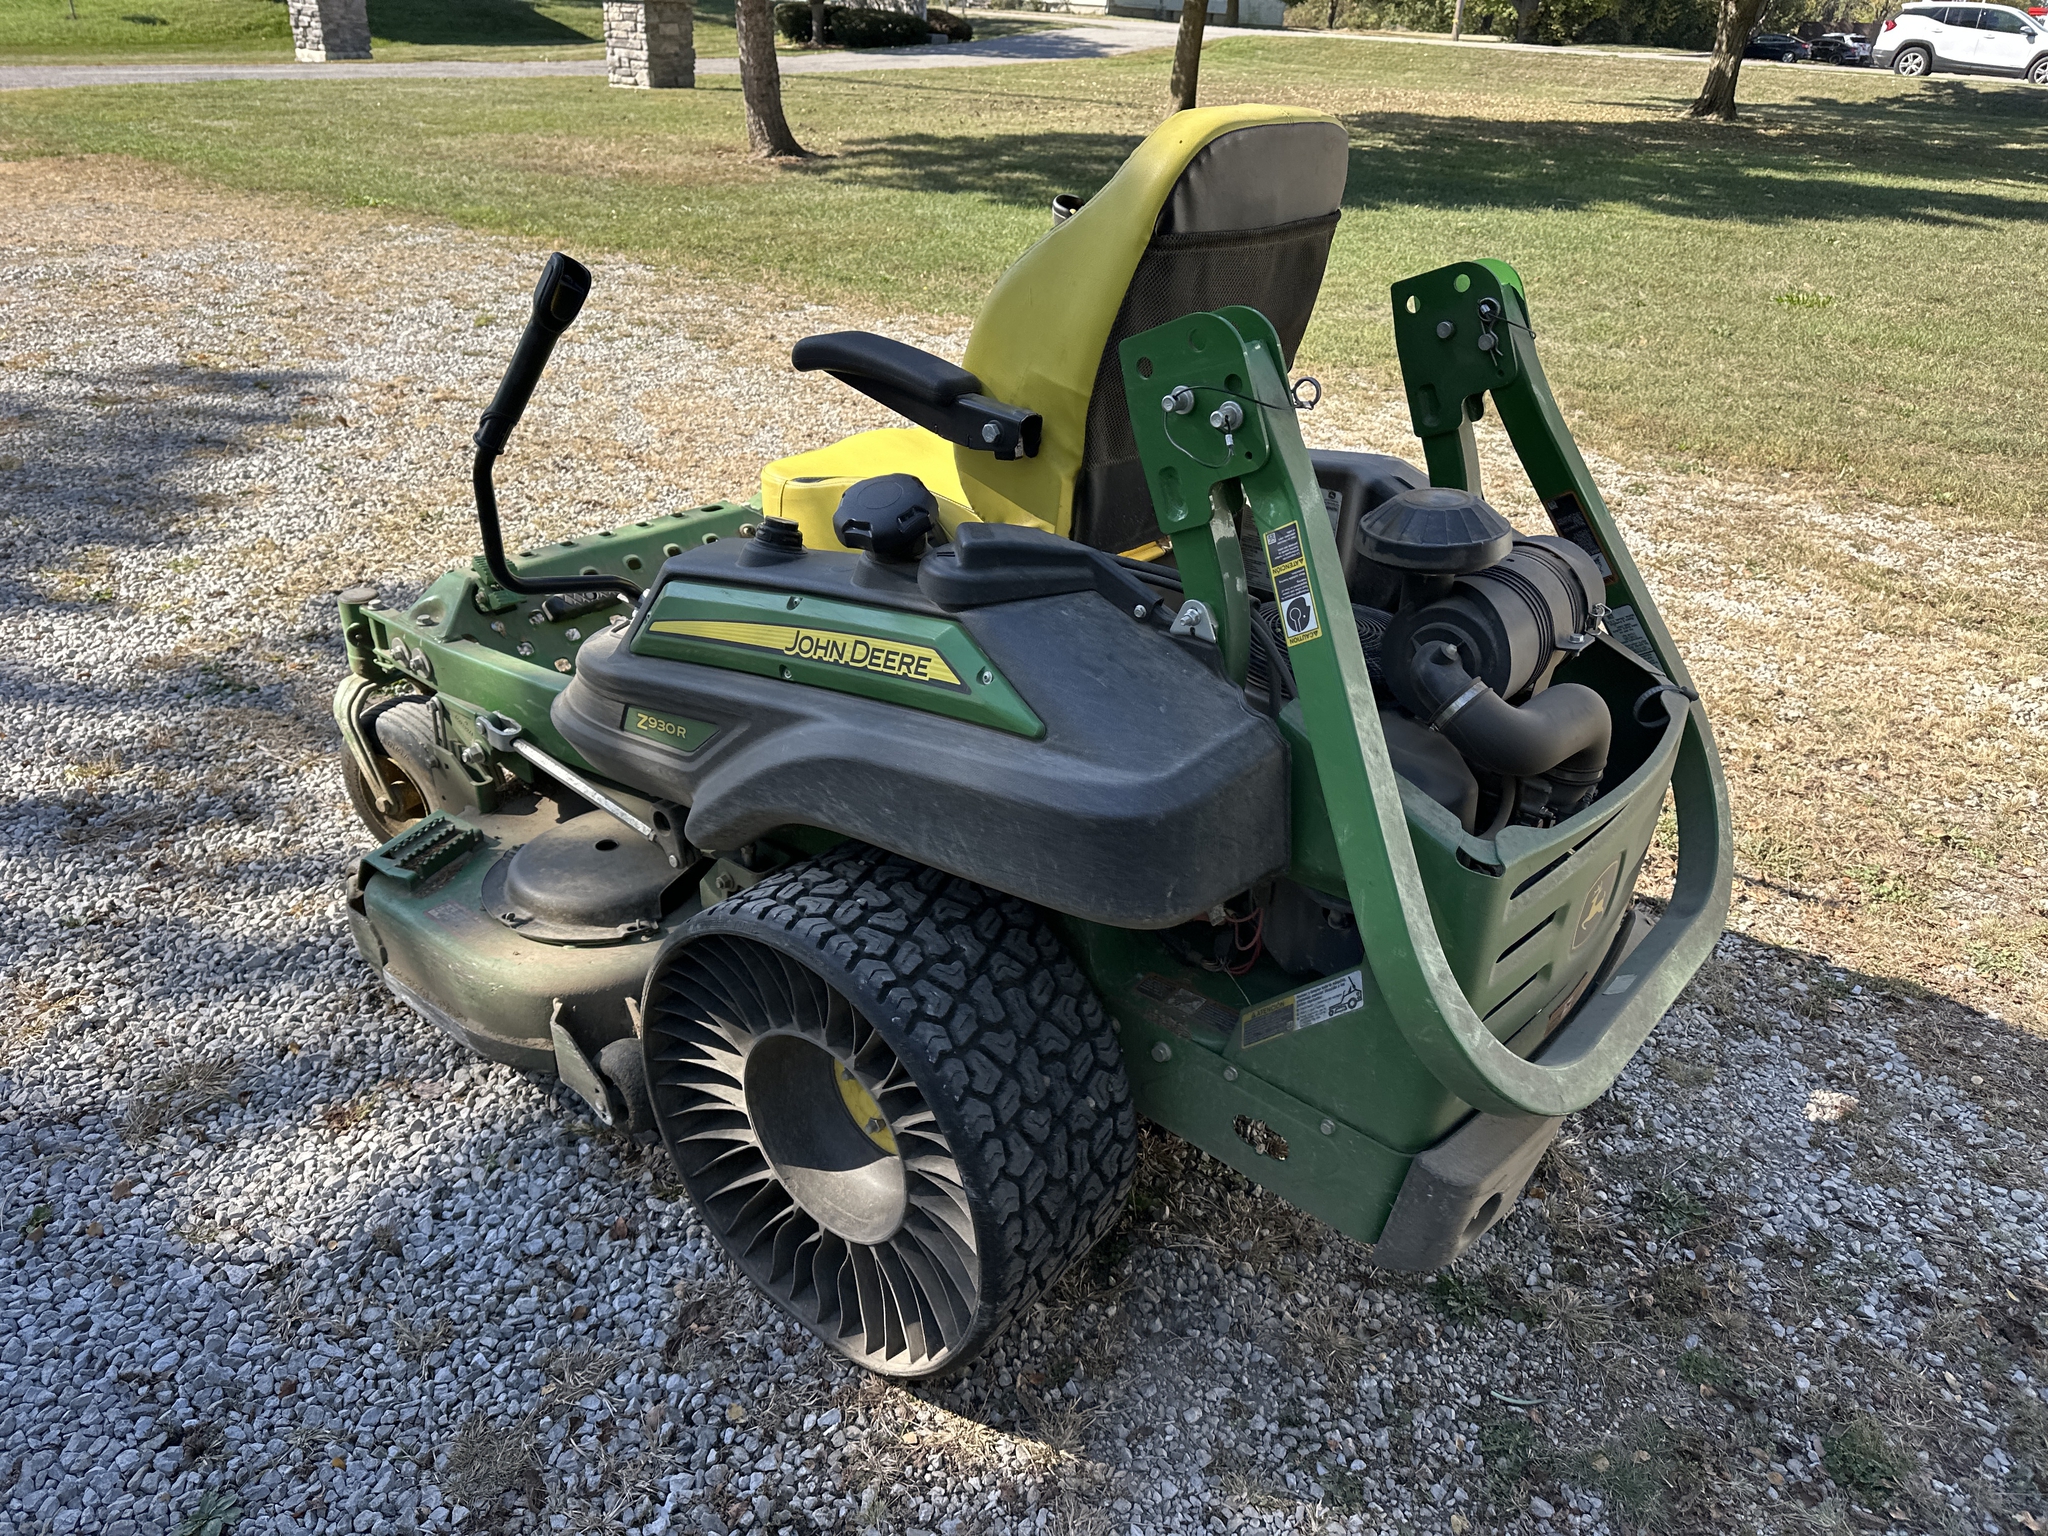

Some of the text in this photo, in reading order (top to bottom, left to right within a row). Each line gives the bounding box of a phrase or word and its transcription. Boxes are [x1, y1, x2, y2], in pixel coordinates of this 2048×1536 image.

[785, 630, 932, 677] JOHN DEERE
[1289, 632, 1314, 645] CAUTION
